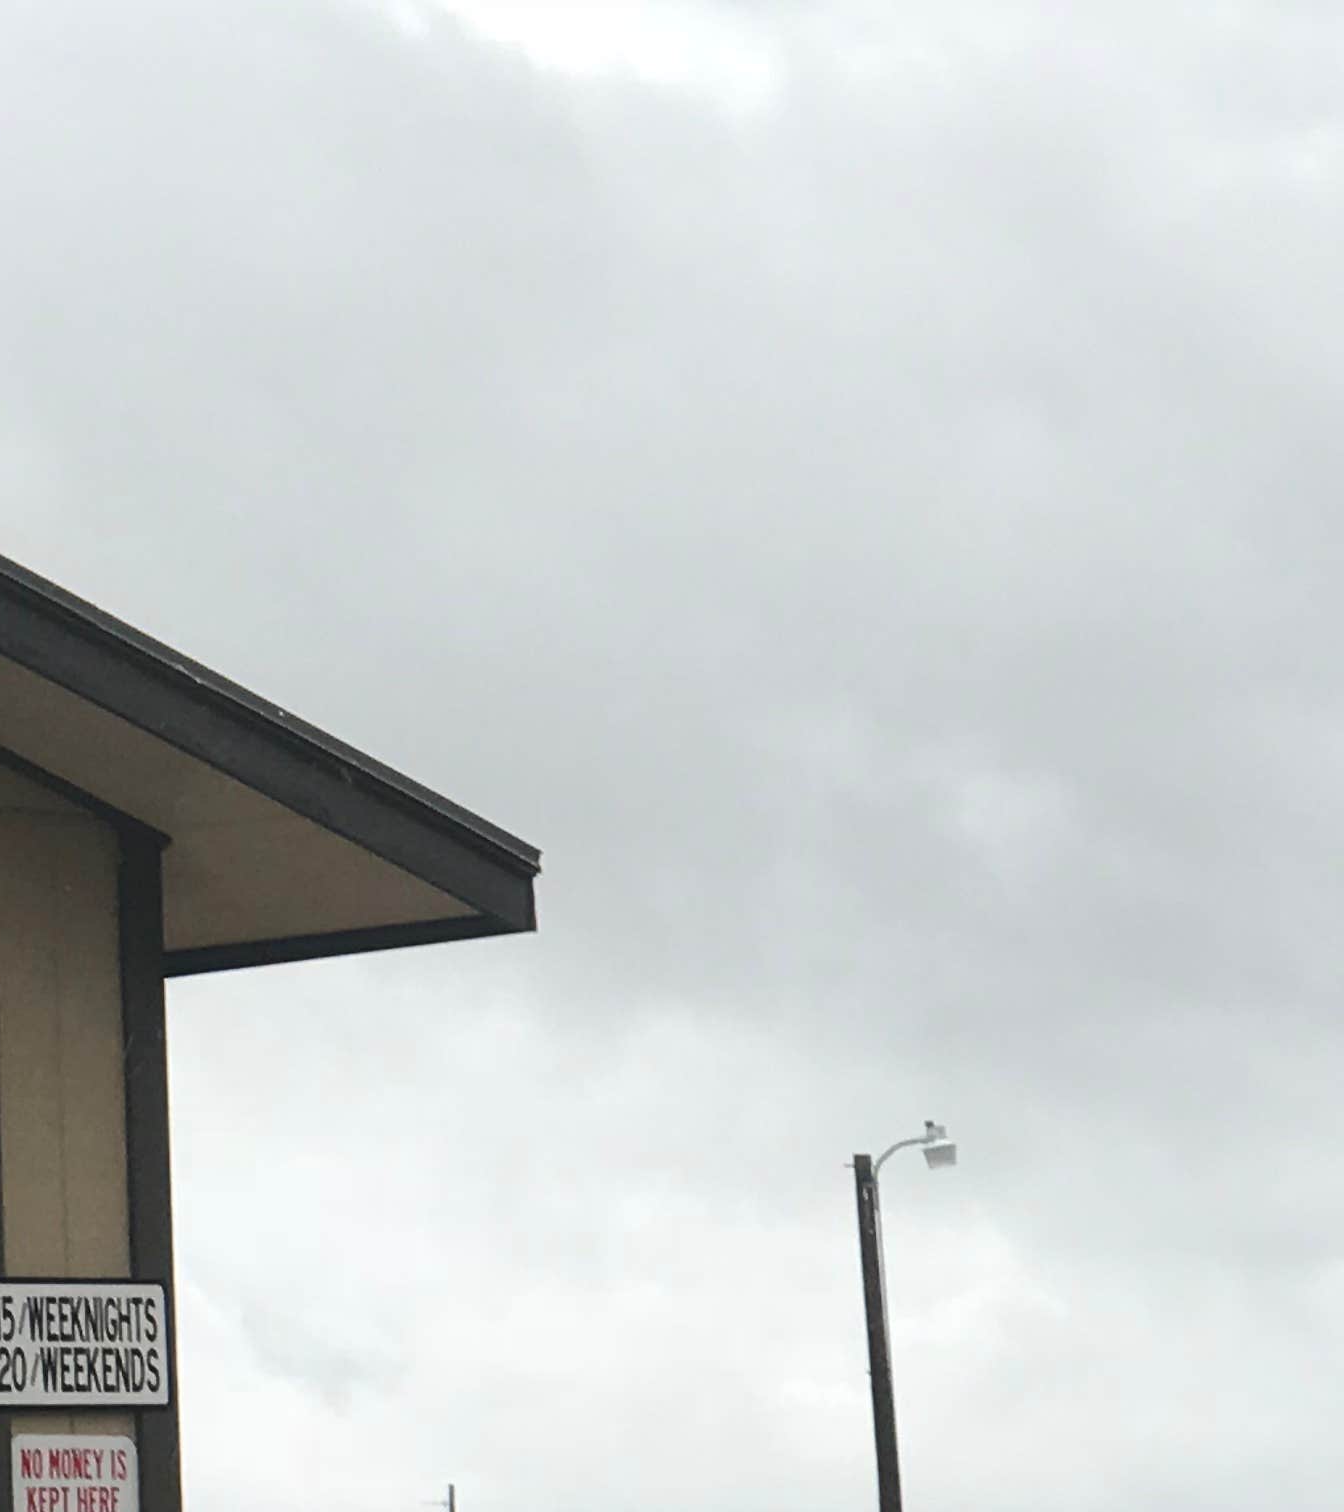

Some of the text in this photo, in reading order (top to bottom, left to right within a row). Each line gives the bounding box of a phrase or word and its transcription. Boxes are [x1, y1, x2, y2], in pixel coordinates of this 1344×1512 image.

[20, 1448, 127, 1480] NO MONEY IS
